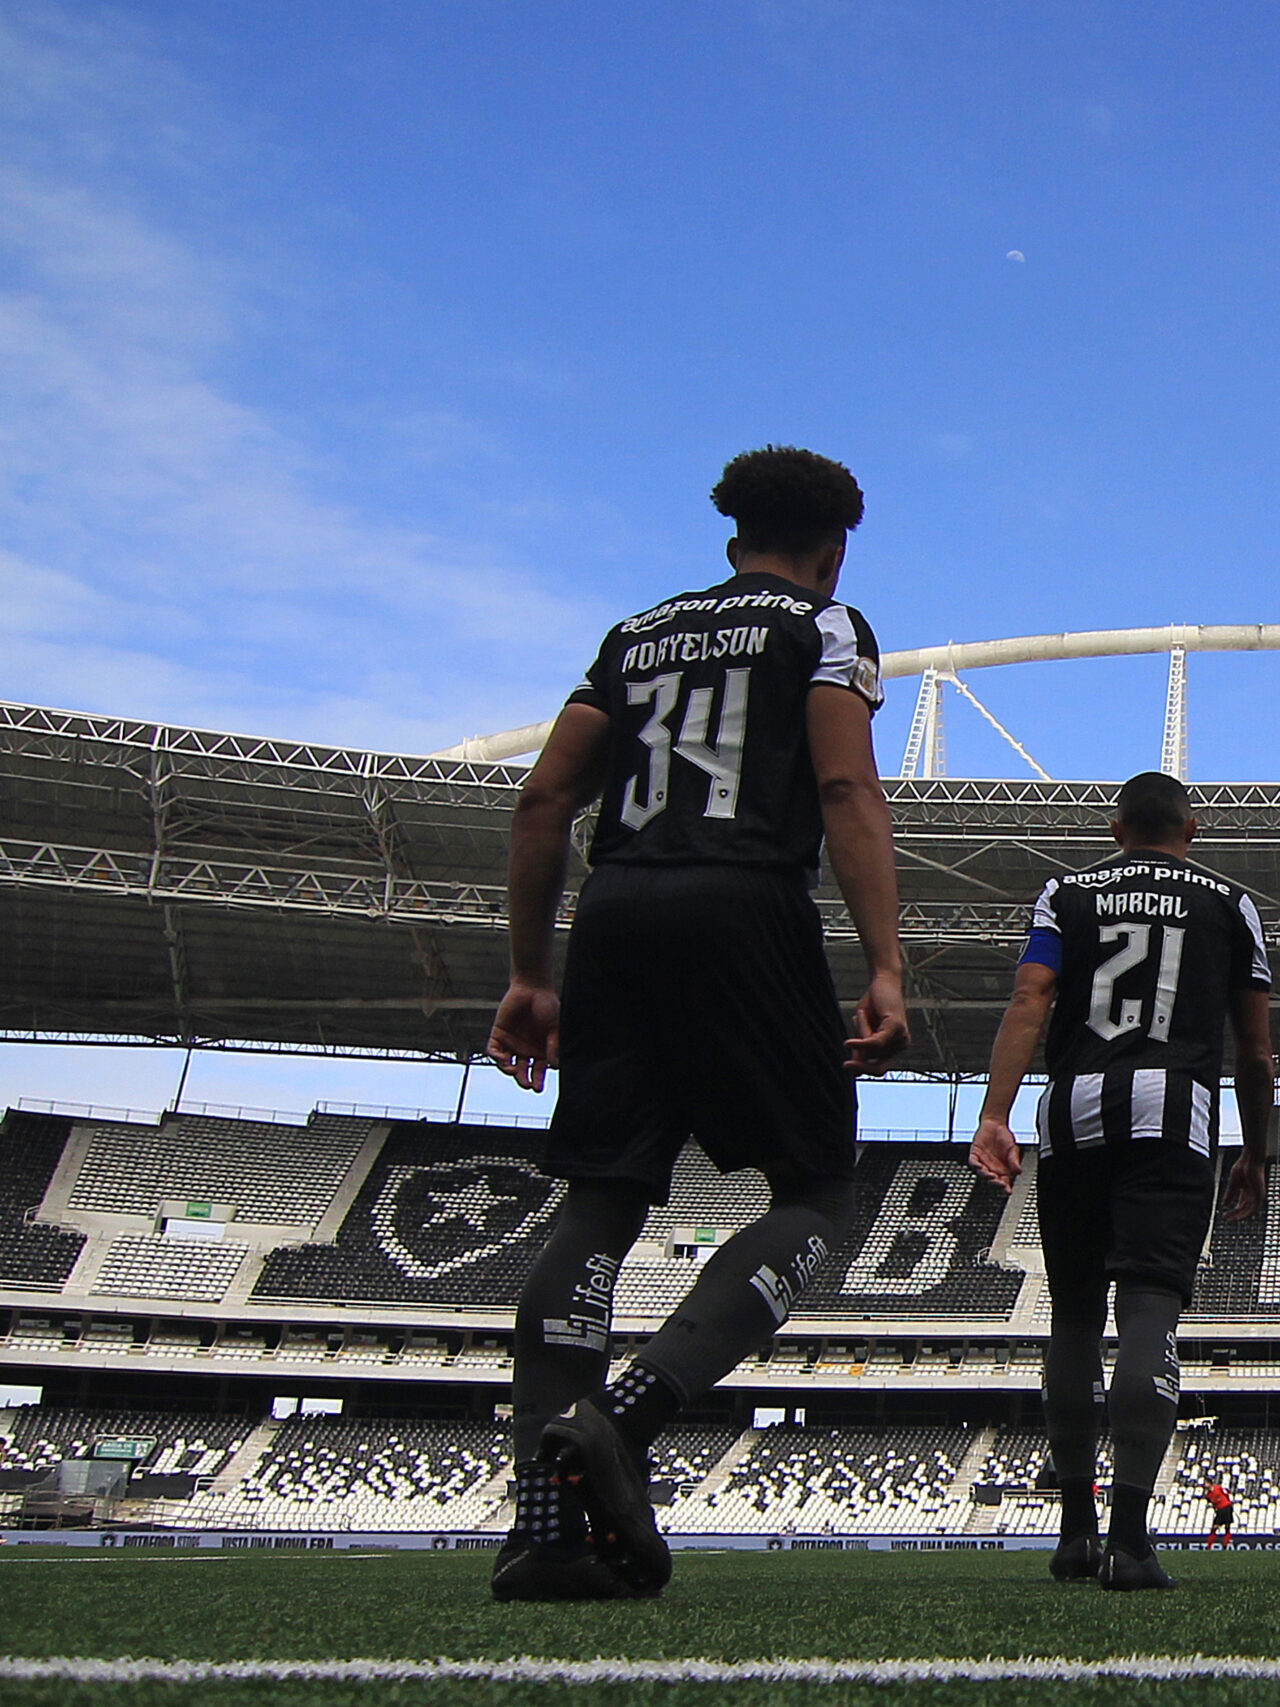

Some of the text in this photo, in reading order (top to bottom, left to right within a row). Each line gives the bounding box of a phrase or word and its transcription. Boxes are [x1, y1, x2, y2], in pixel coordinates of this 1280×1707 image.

[620, 590, 814, 633] amazon prime
[621, 626, 770, 673] ADRYELSON
[620, 667, 752, 832] 34
[1062, 865, 1231, 896] amazon prime
[1085, 922, 1186, 1042] 21
[839, 1160, 977, 1296] B
[570, 1253, 619, 1327] Lifefit
